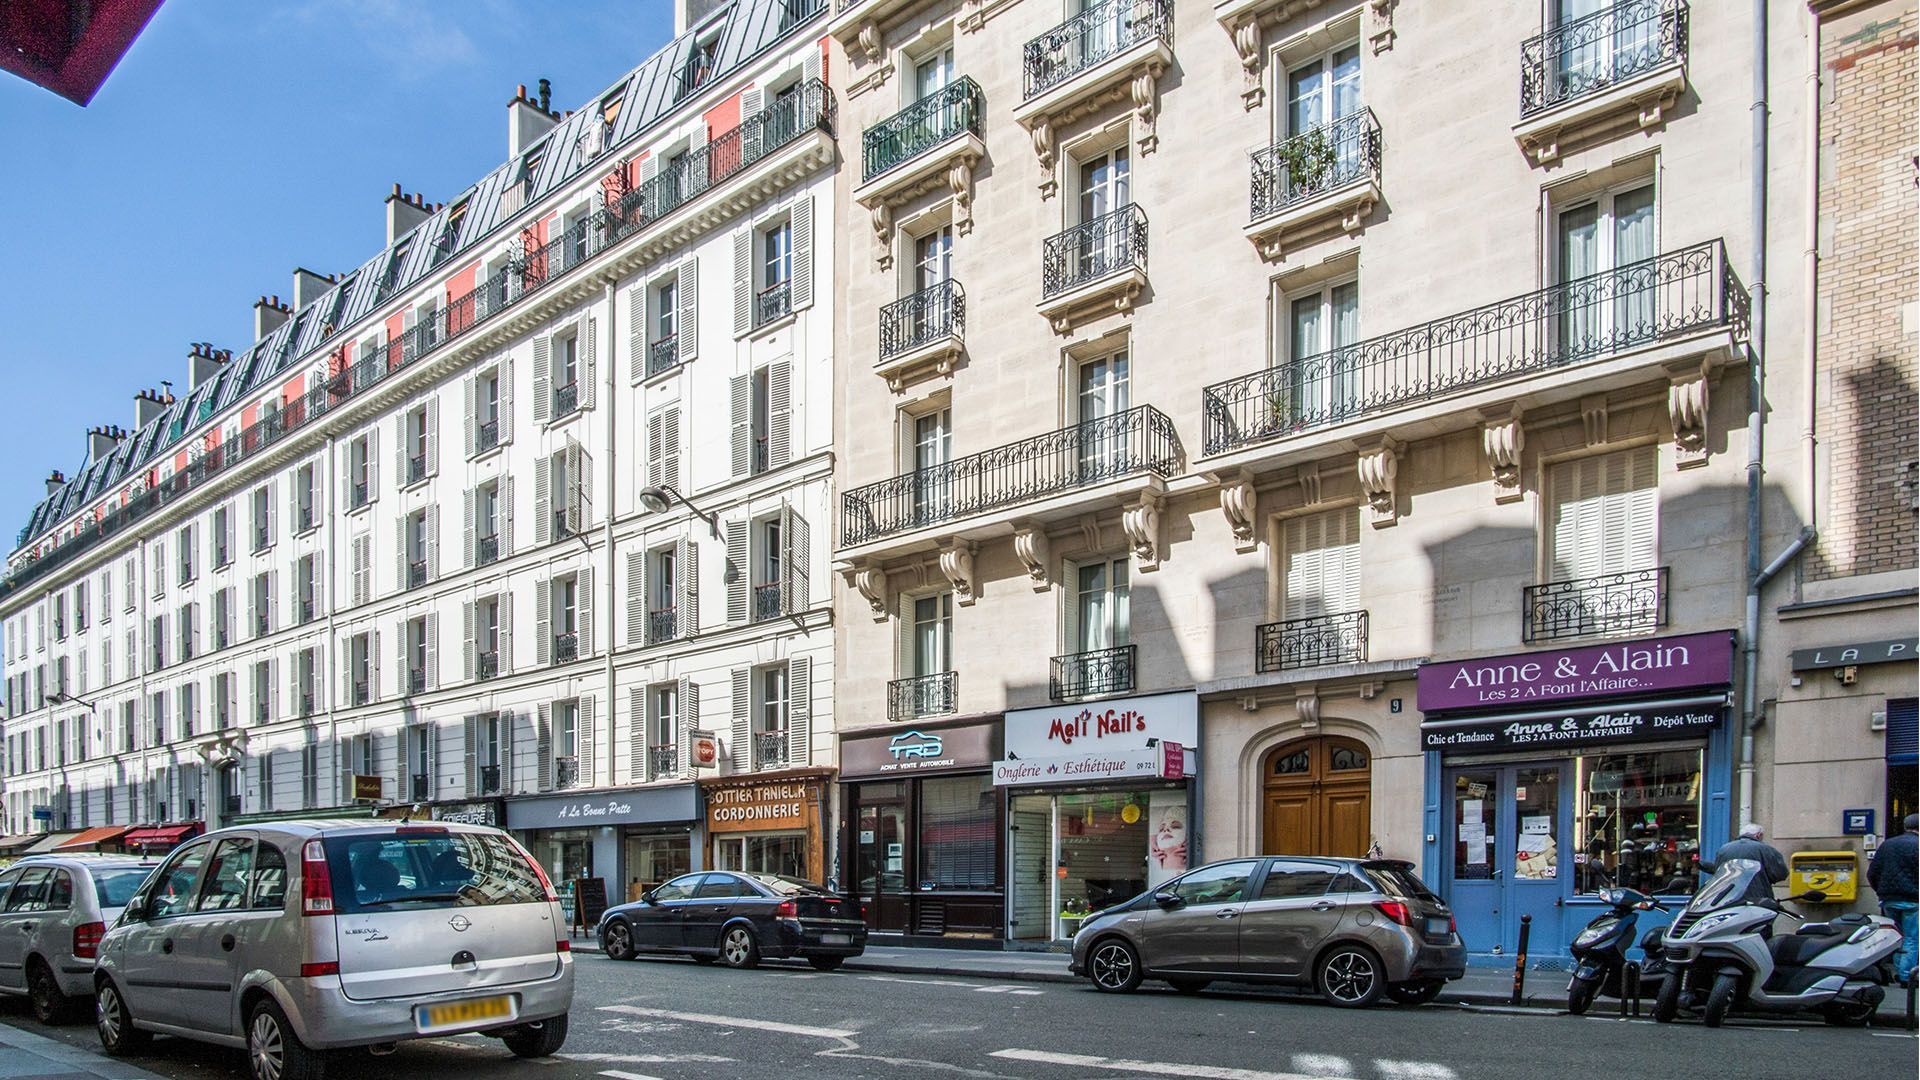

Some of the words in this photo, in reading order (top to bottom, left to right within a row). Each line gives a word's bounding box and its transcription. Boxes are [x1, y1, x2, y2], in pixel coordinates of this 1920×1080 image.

[1814, 648, 1859, 664] LA
[1887, 643, 1919, 656] P
[1449, 662, 1541, 689] Anne
[1554, 656, 1580, 679] &
[1591, 643, 1689, 675] Alain
[1479, 690, 1506, 701] Les
[1510, 687, 1520, 698] 2
[1524, 686, 1536, 697] A
[1541, 683, 1575, 696] Font
[1392, 700, 1400, 712] 9
[1097, 709, 1146, 738] Nail's
[1503, 722, 1554, 736] Anne
[1560, 717, 1579, 730] &
[1588, 713, 1643, 728] Alain
[1653, 715, 1683, 728] Dépôt
[1685, 714, 1714, 725] Vente
[1427, 733, 1446, 745] Chic
[1447, 735, 1455, 743] et
[1456, 732, 1495, 743] Tendance
[1512, 734, 1531, 743] LES
[1533, 733, 1539, 741] 2
[1540, 732, 1548, 741] A
[1549, 730, 1578, 740] FONT
[1580, 726, 1633, 738] L'AFFAIRE
[888, 742, 943, 759] TRD
[900, 762, 917, 770] VENTE
[920, 759, 955, 768] AUTOMOBILE
[997, 762, 1041, 782] Onglerie
[1063, 757, 1126, 776] Esthétique
[1136, 762, 1144, 770] 09
[558, 806, 567, 818] A
[568, 805, 580, 817] La
[583, 803, 606, 816] Bonne
[608, 801, 631, 815] Patte
[714, 803, 800, 821] CORDONNERIE
